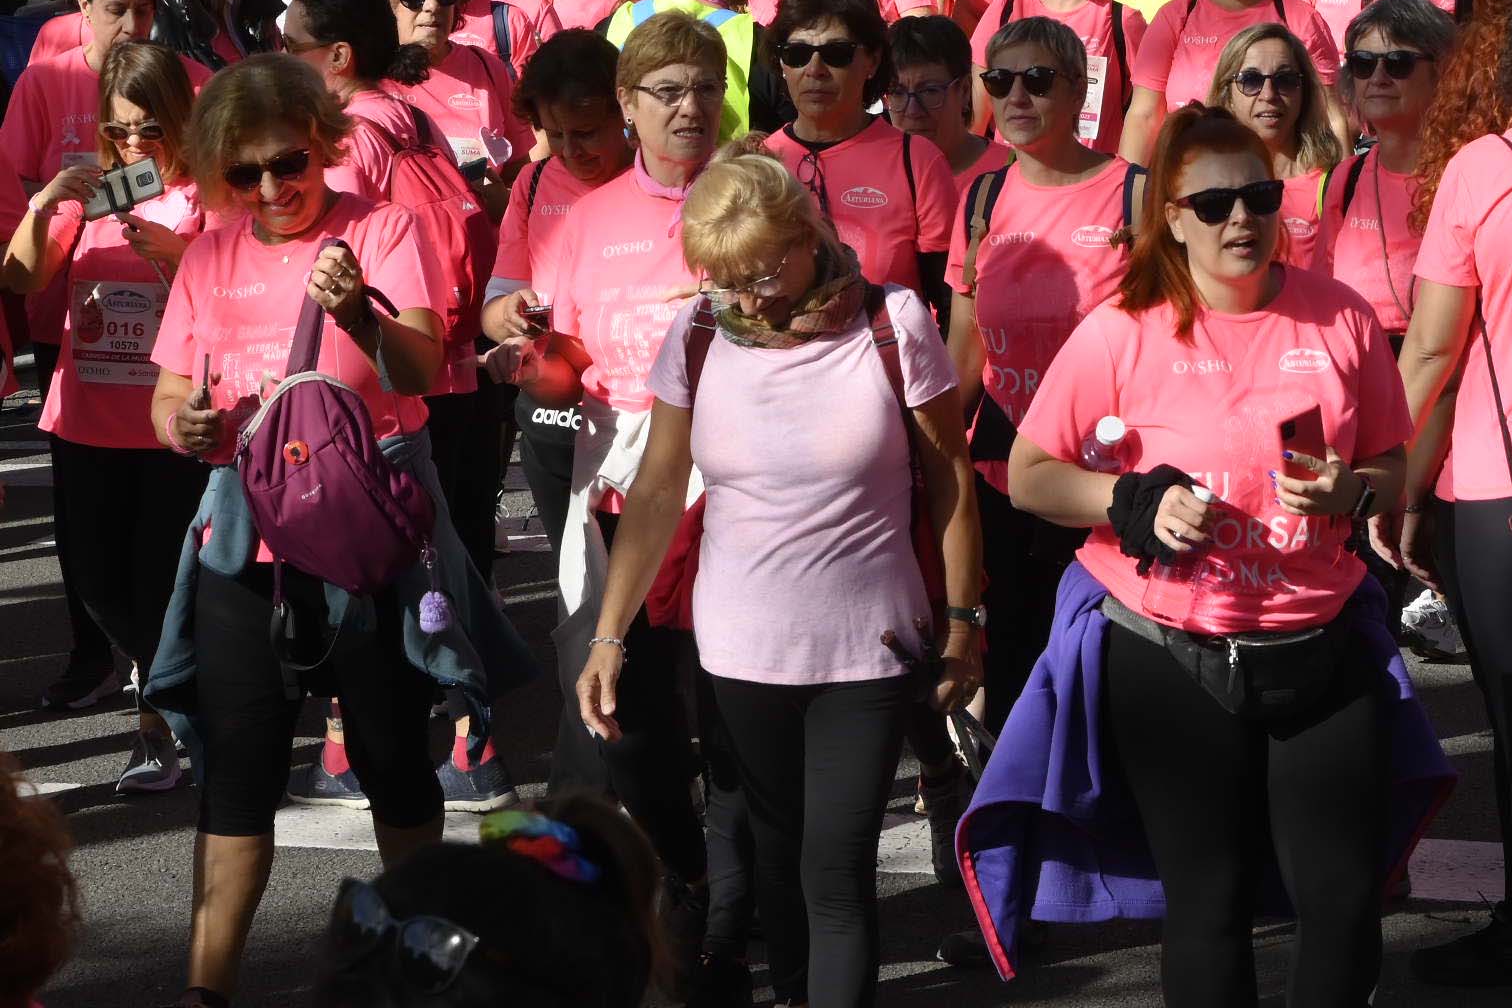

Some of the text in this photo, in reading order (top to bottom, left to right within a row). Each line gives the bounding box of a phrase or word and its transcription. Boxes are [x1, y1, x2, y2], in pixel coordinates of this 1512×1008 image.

[602, 239, 654, 259] OYSHO
[106, 321, 145, 338] 016
[109, 340, 139, 351] 10579
[1172, 359, 1232, 376] OYSHO
